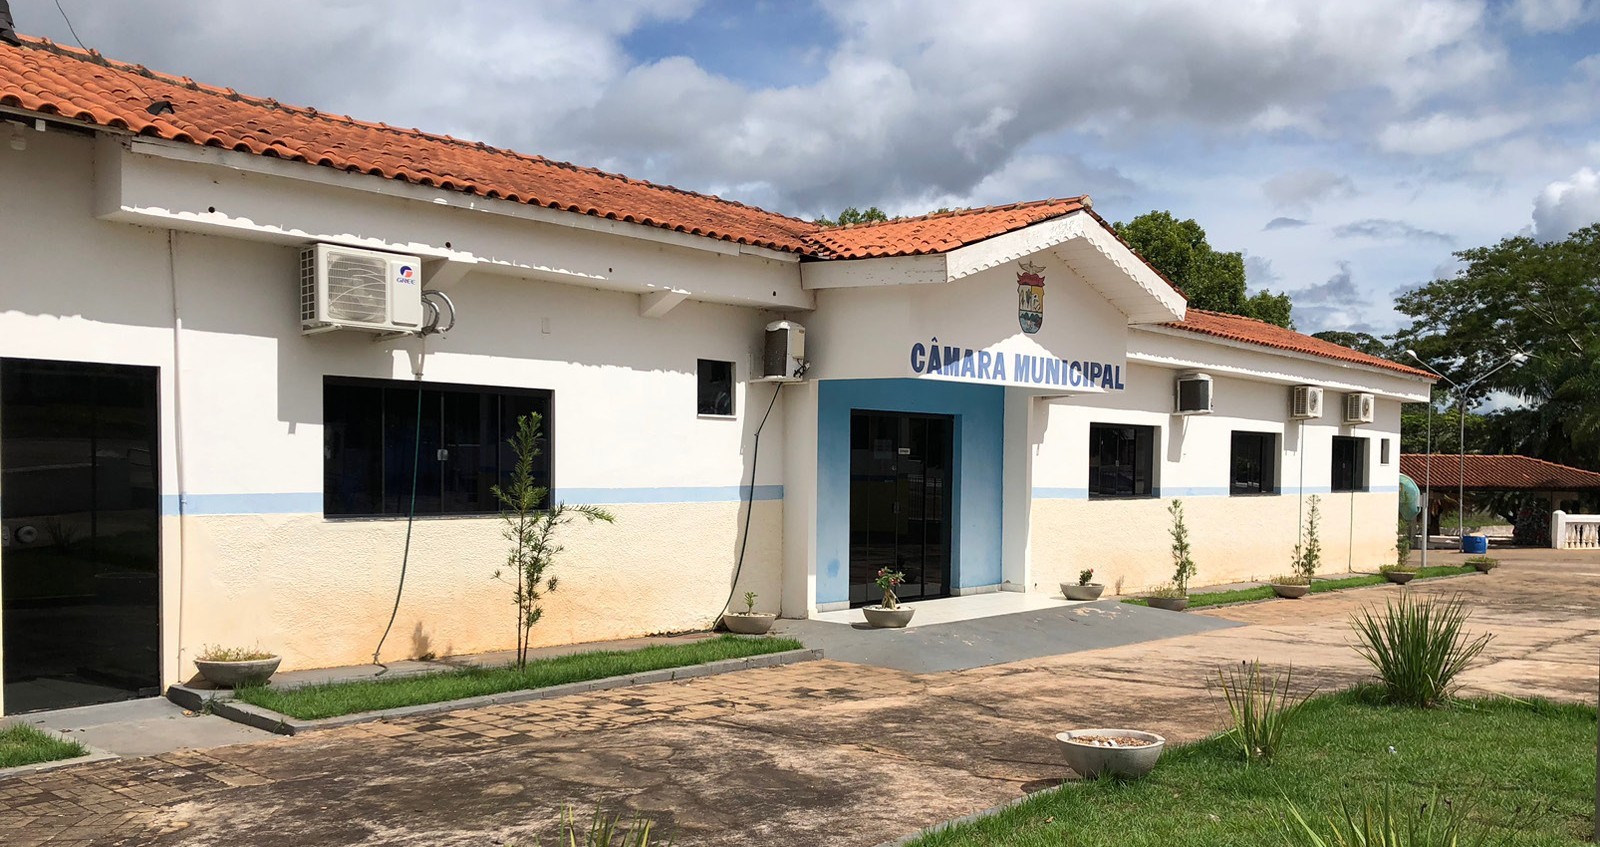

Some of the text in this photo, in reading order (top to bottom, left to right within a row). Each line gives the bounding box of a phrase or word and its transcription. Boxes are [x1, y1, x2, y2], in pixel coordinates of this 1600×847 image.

[396, 277, 416, 285] GREE
[910, 337, 1125, 390] CÂMARA MUNICIPAL
